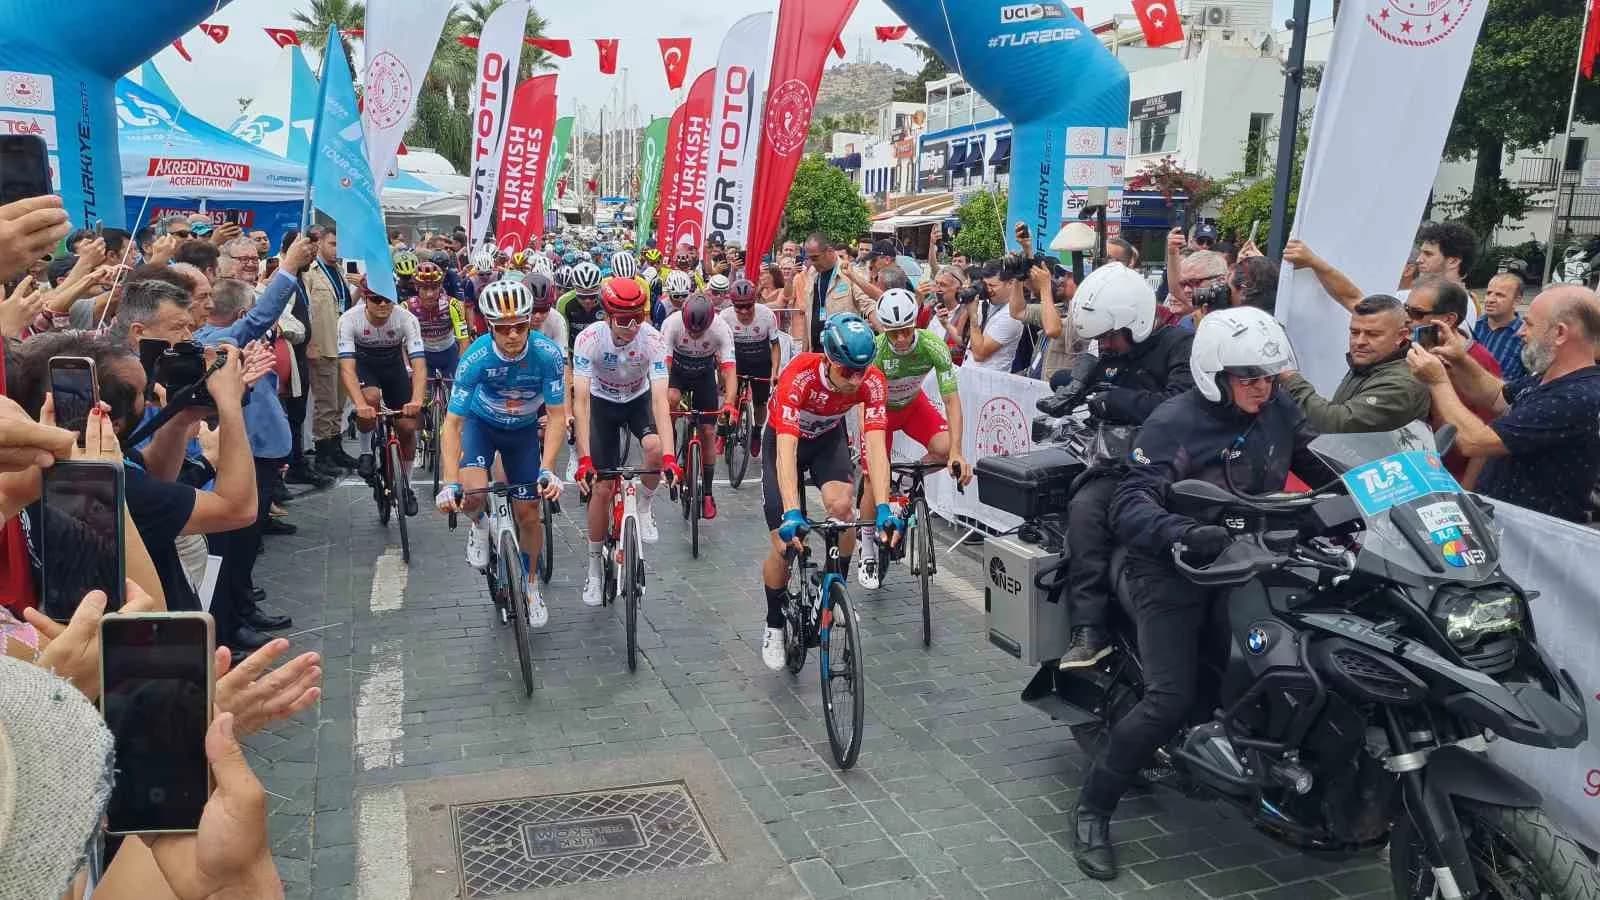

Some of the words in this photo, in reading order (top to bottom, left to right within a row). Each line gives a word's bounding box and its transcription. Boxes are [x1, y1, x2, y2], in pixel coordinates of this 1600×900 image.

[1003, 7, 1028, 20] UCI
[475, 52, 503, 161] TOTO
[717, 65, 748, 175] TOTO
[502, 126, 526, 222] TURKISH
[518, 128, 543, 227] AIRLINES
[680, 116, 704, 209] TURKISH
[169, 176, 232, 188] ACCREDITATION
[1357, 459, 1409, 494] TUR
[1225, 518, 1245, 529] GS
[1461, 549, 1486, 566] NEP
[999, 574, 1022, 596] NEP
